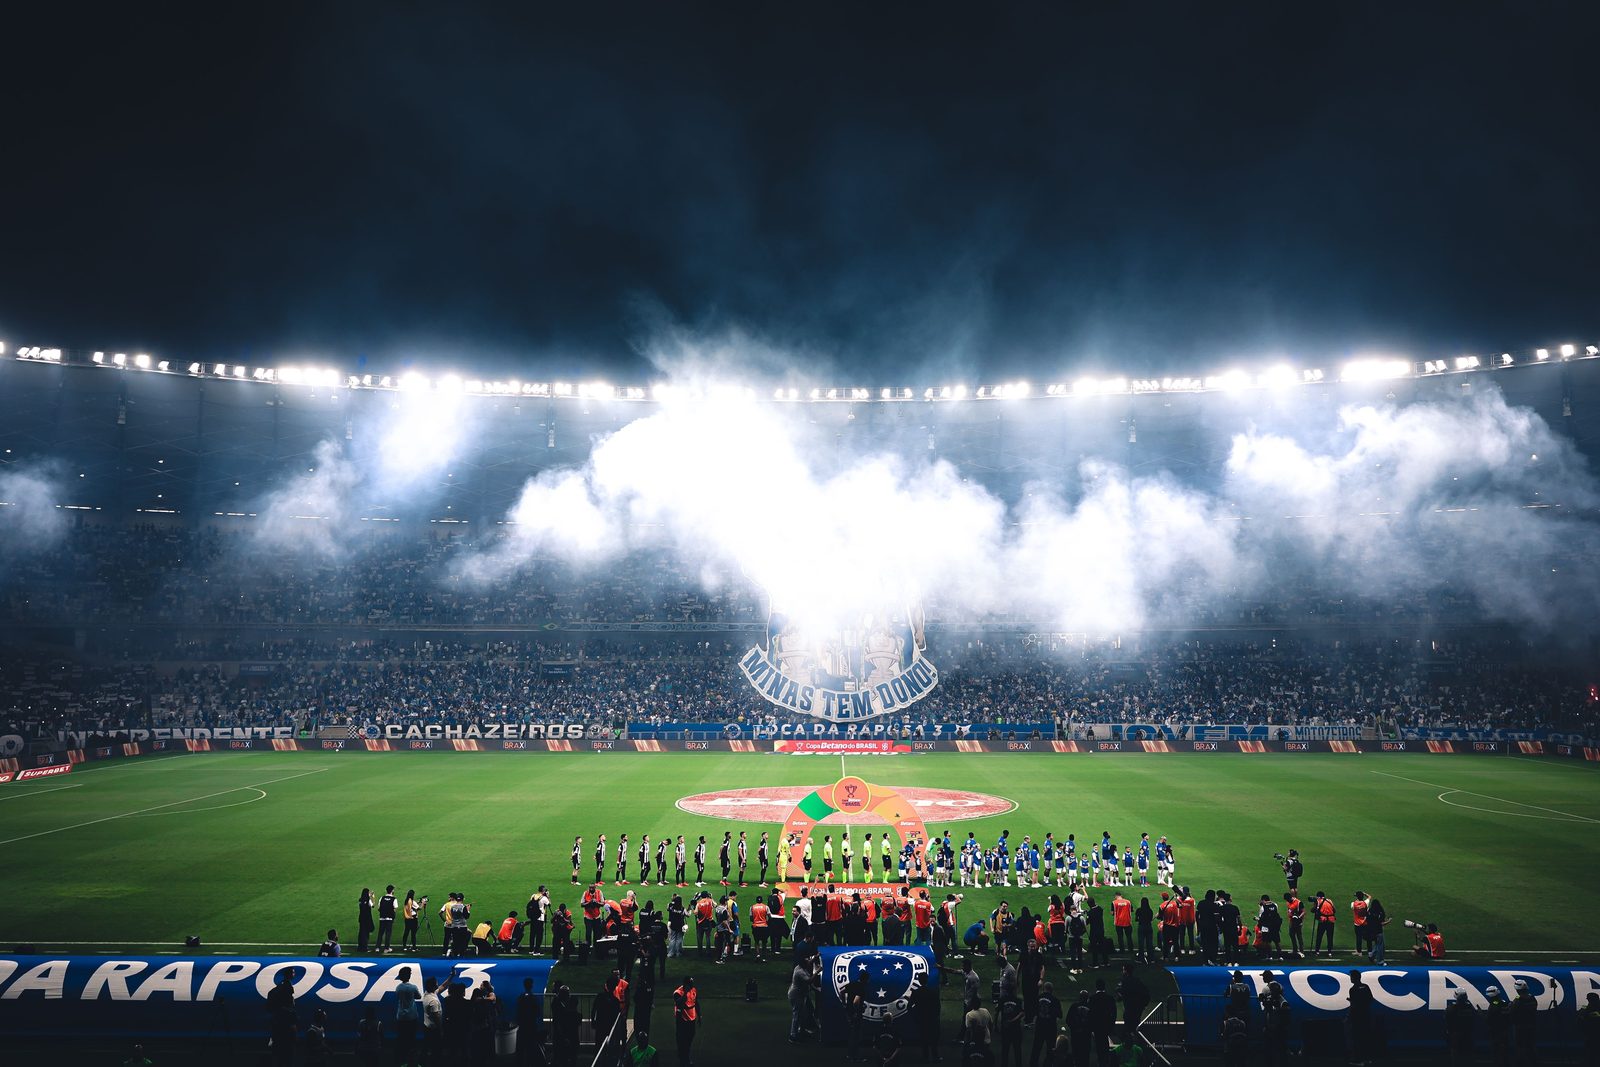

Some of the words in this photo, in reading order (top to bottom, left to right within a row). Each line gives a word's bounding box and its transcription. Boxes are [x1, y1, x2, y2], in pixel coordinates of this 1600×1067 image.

[743, 650, 815, 713] MINAS
[822, 690, 875, 720] TEM
[875, 657, 937, 710] DONO!
[385, 723, 584, 739] CACHAZEIROS
[813, 723, 839, 735] DA
[932, 724, 943, 736] 3
[231, 741, 250, 749] BRAX
[323, 741, 344, 749] BRAX
[411, 741, 431, 749] BRAX
[504, 741, 525, 749] BRAX
[593, 741, 613, 749] BRAX
[687, 742, 708, 750] BRAX
[914, 742, 934, 750] BRAX
[1009, 742, 1030, 750] BRAX
[1100, 742, 1120, 750] BRAX
[1475, 743, 1496, 751] BRAX
[24, 765, 70, 777] SUPERBET
[80, 960, 424, 1002] RAPOSA
[440, 963, 498, 1001] 3
[1227, 969, 1491, 1011] TOCA
